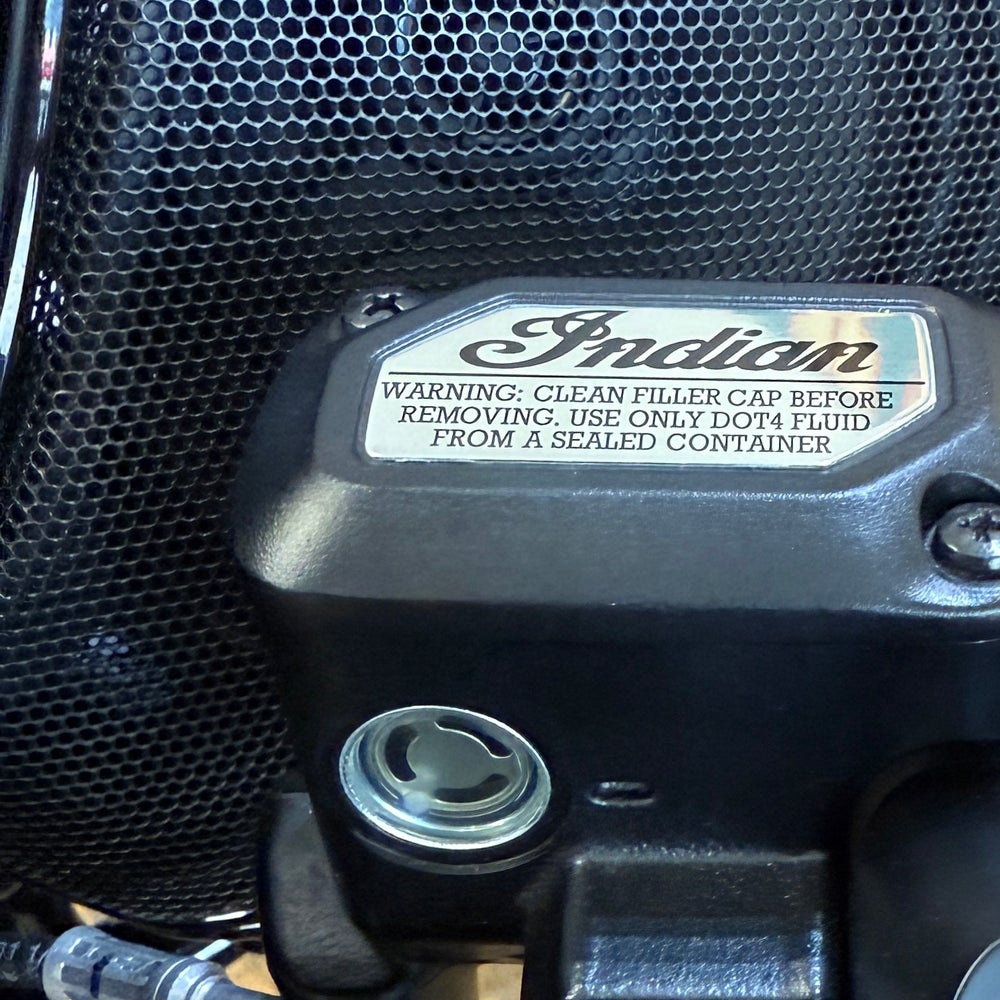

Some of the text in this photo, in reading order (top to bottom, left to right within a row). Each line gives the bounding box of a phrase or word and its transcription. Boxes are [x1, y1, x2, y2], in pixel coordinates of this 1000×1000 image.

[459, 310, 878, 374] Indian
[381, 381, 893, 410] WARNING: CLEAN FILLER CAP BEFORE
[398, 405, 871, 432] REMOVING. USE ONLY DOT4 FLUID
[430, 429, 833, 455] FROM A SEALED CONTAINER
